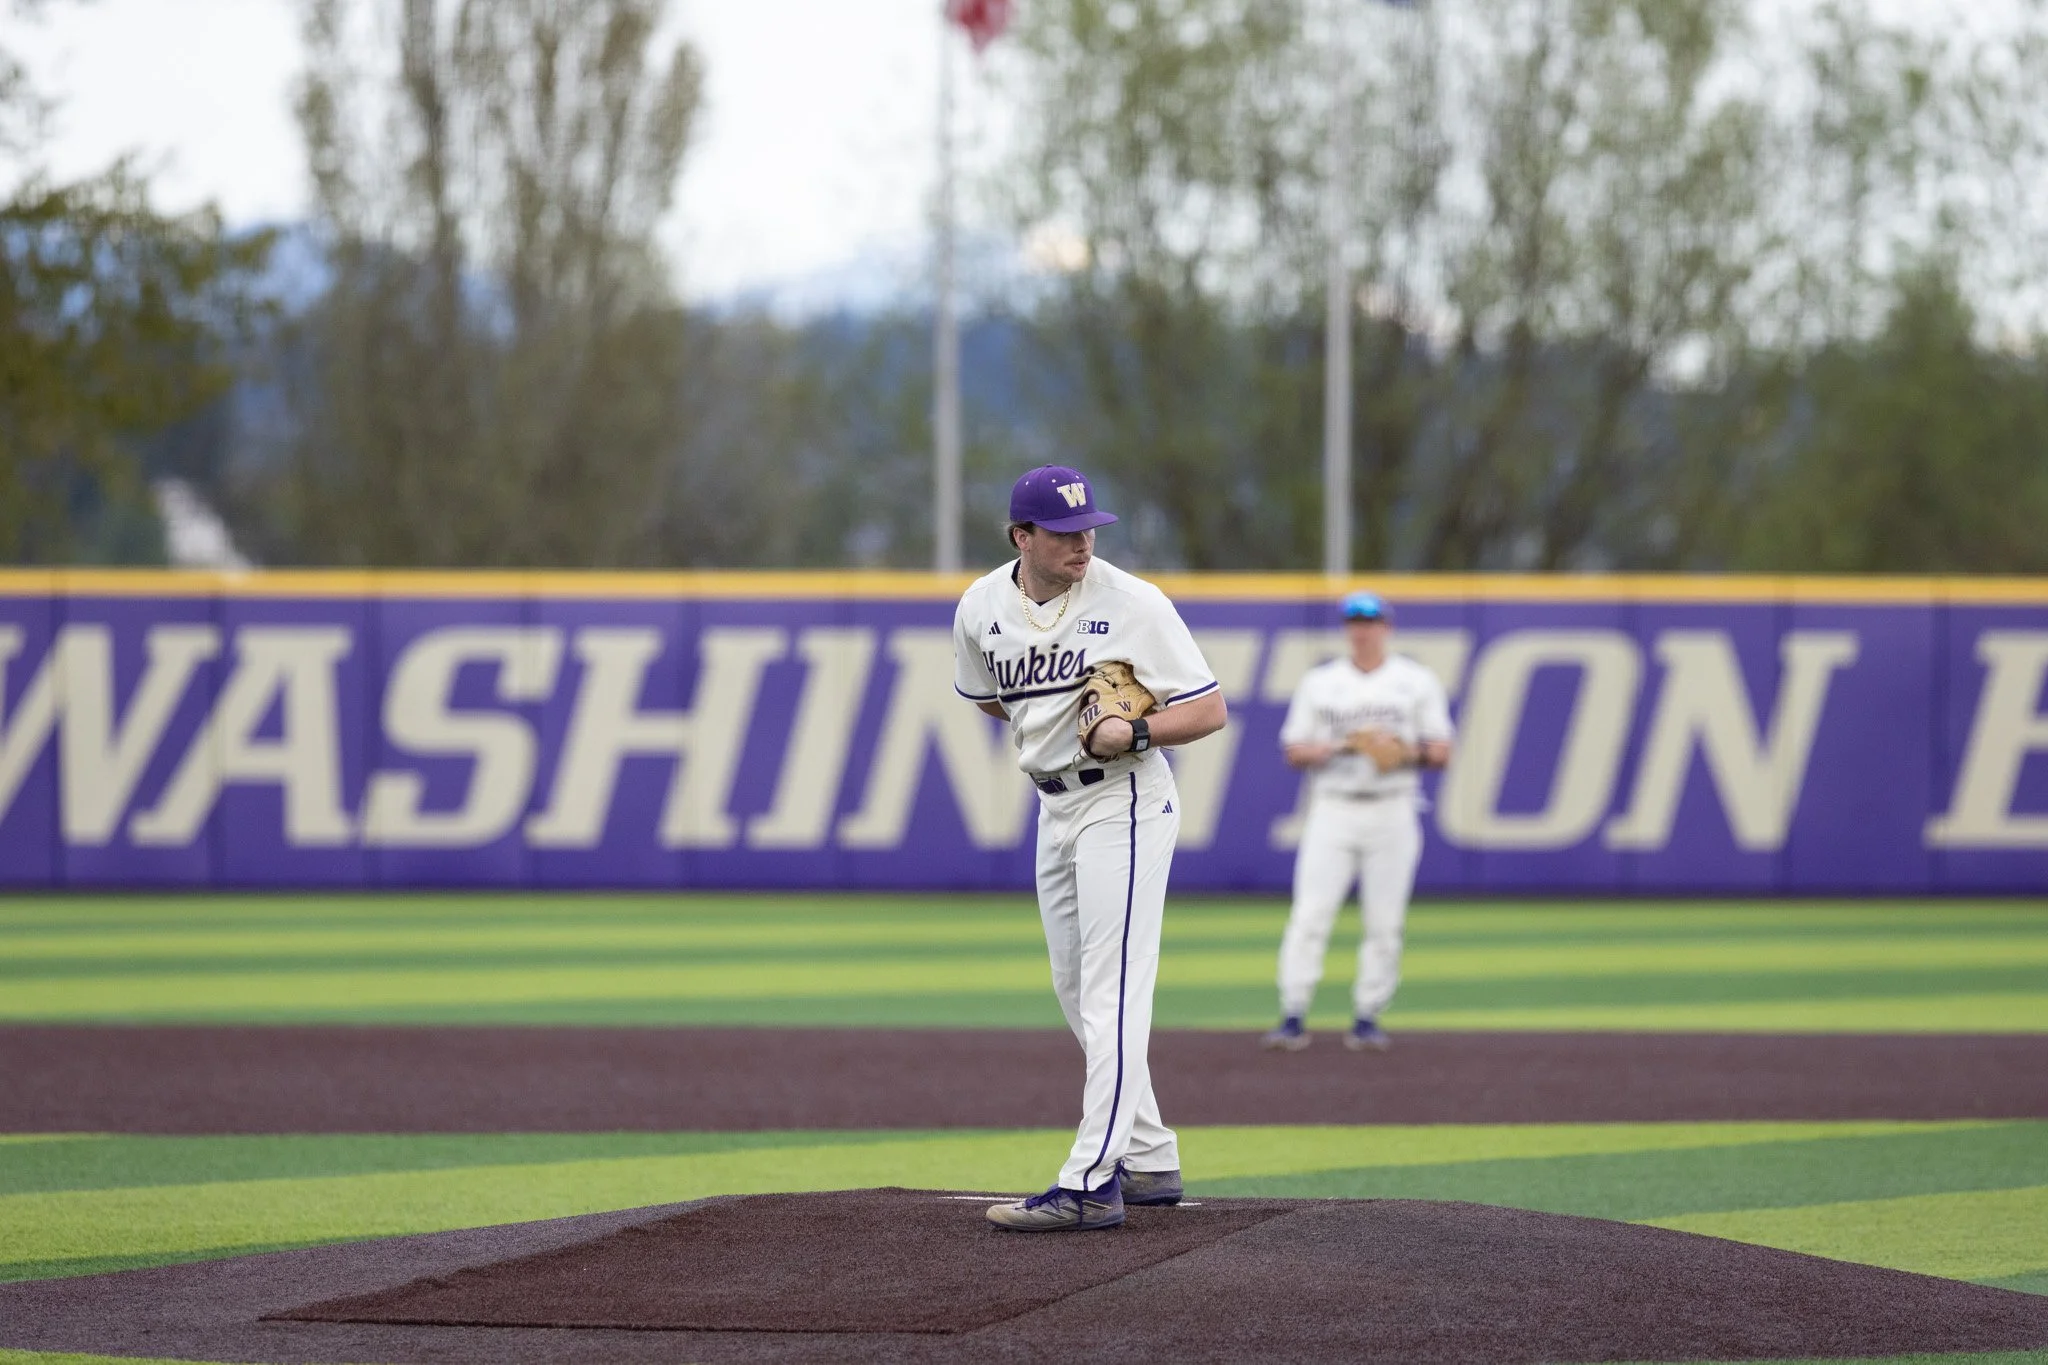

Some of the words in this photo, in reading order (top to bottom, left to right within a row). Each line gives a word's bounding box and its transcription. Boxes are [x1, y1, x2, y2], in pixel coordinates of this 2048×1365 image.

[1056, 482, 1087, 508] W
[982, 642, 1096, 690] Huskies
[1115, 700, 1131, 713] W
